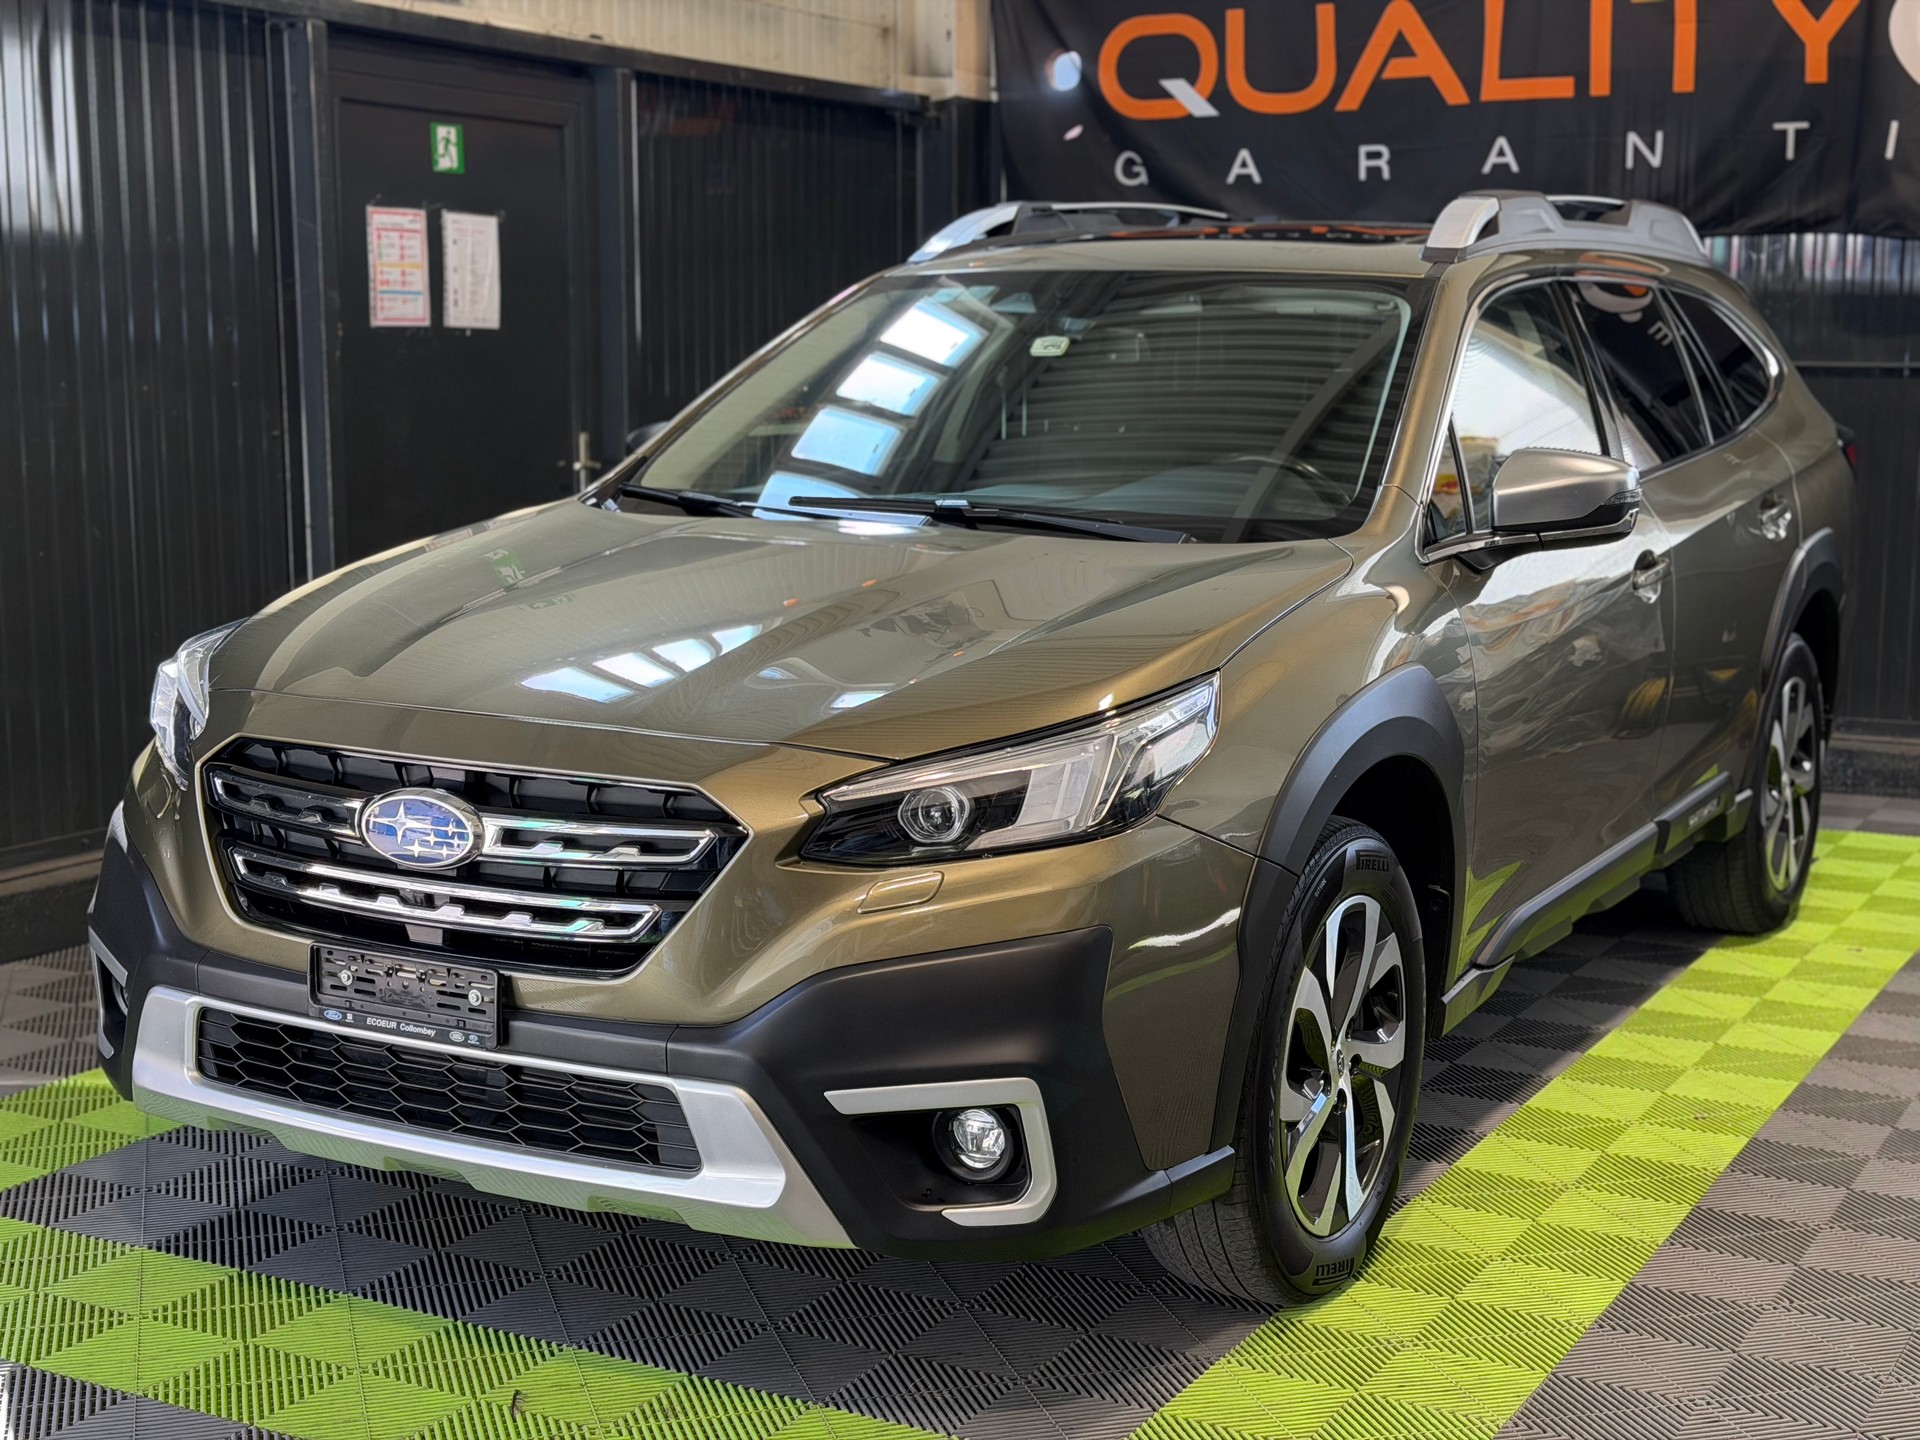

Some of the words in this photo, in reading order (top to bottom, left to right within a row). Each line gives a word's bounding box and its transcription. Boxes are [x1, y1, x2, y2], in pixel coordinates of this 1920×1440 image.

[1097, 0, 1862, 120] QUALITY
[1355, 850, 1389, 872] PIRELLI
[366, 1017, 397, 1029] ECOEUR
[400, 1023, 436, 1038] Collombey
[1312, 1257, 1355, 1286] PIRELLI
